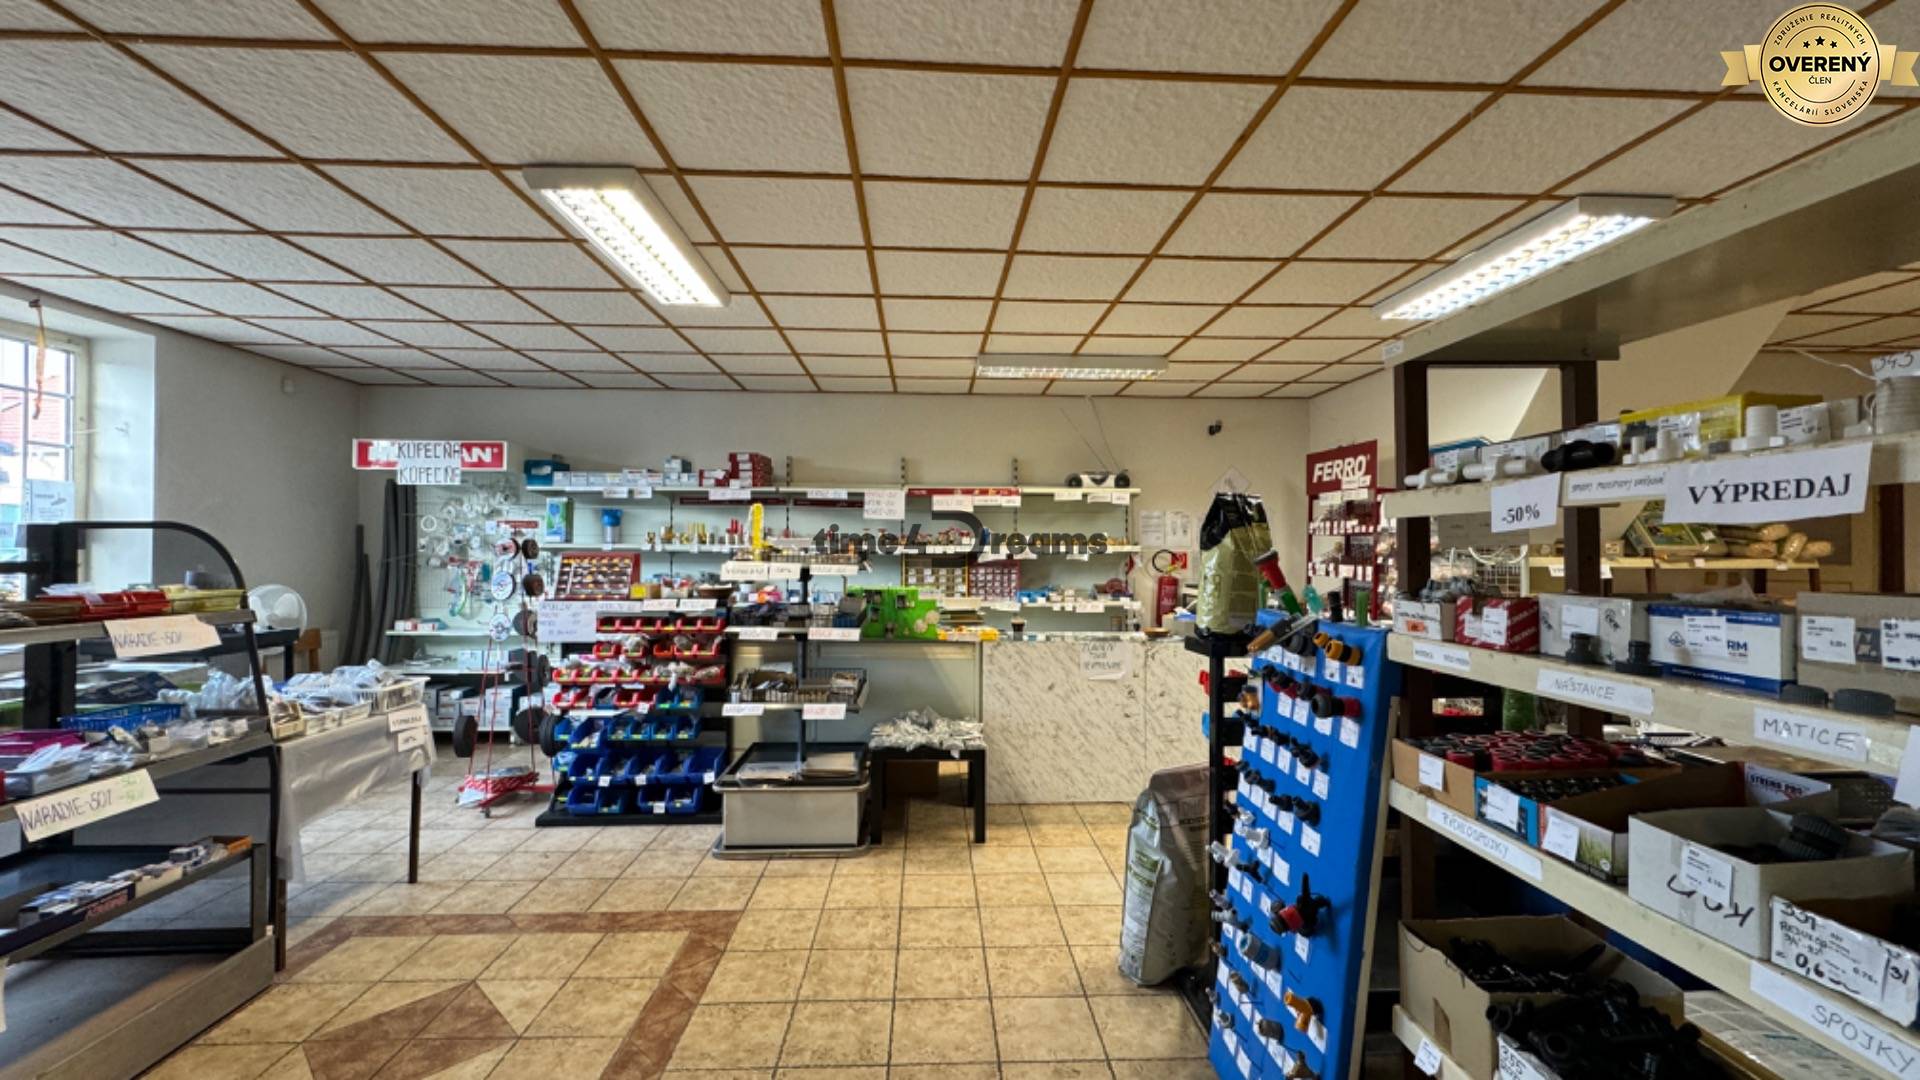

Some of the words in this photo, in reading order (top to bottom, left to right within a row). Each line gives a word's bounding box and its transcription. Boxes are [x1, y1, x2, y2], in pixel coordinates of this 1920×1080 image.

[1311, 455, 1368, 484] FERRO
[1687, 472, 1852, 505] VÝPREDAJ
[1501, 503, 1541, 525] -50%
[1763, 718, 1861, 751] MATICE
[1810, 1003, 1916, 1074] SPOJKY
